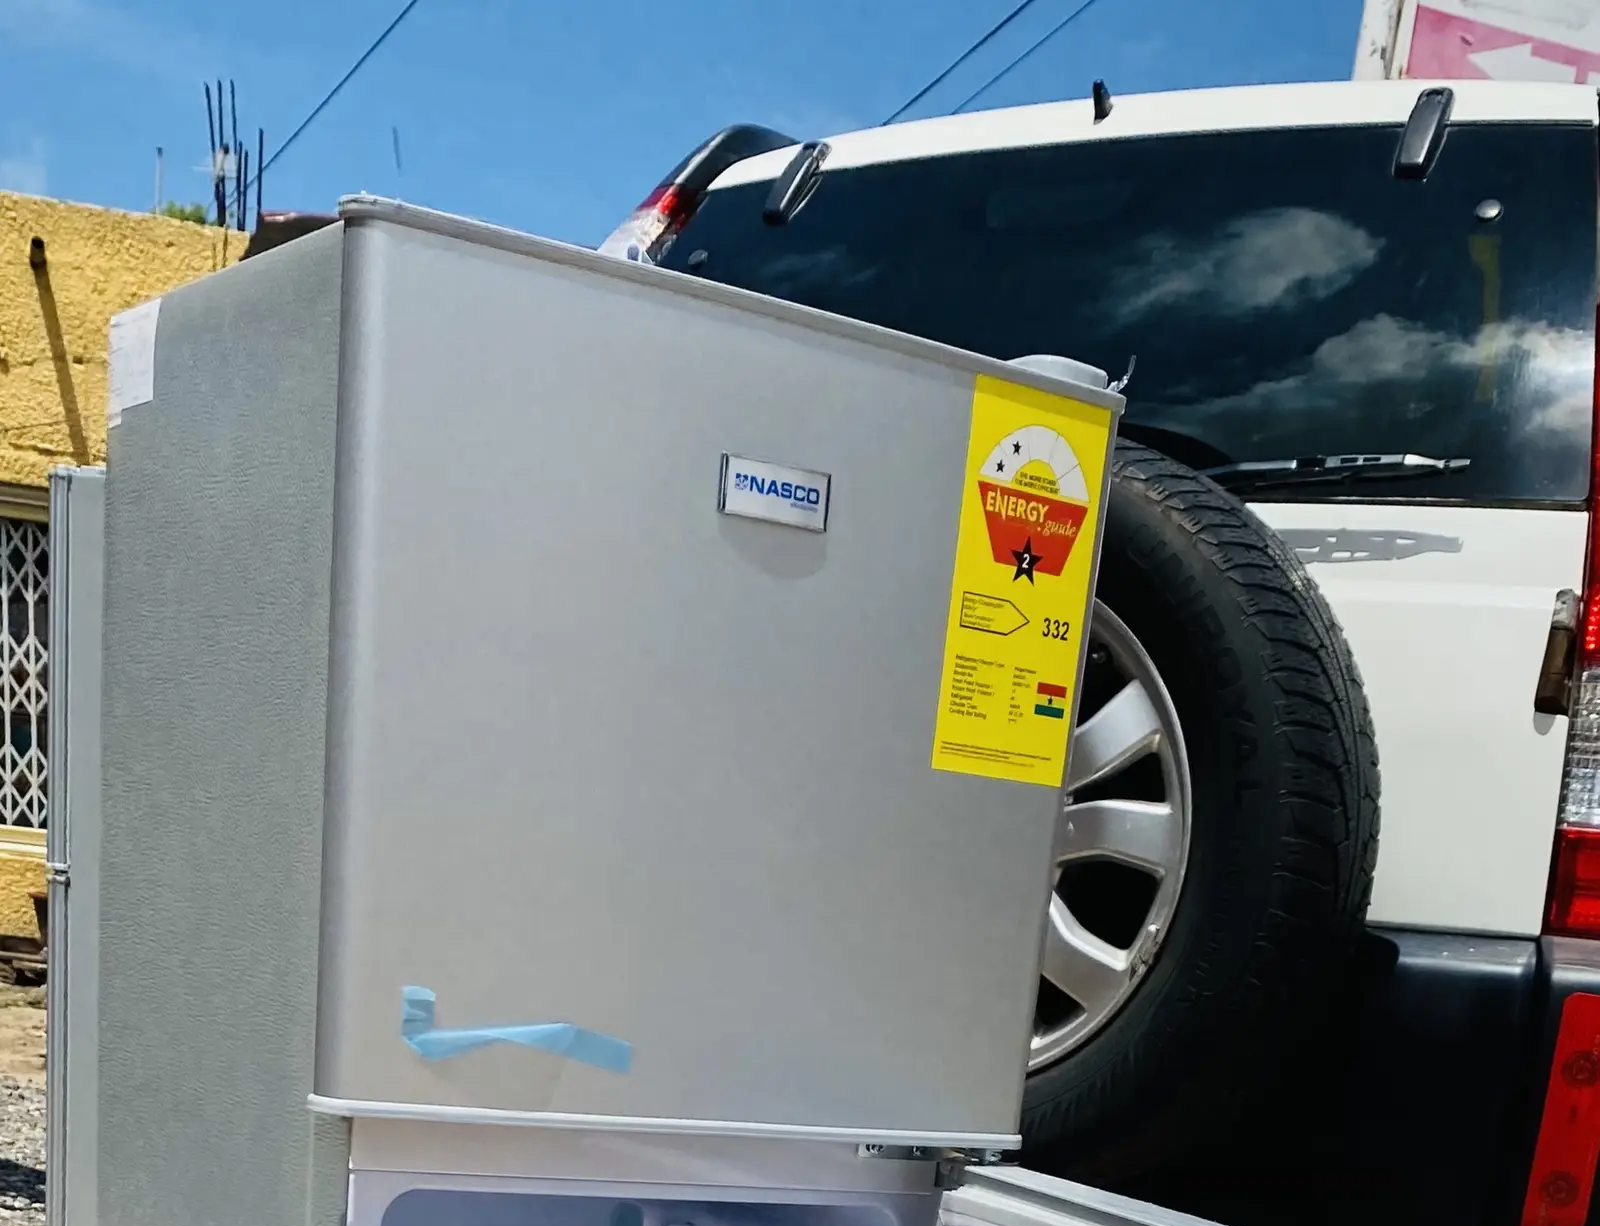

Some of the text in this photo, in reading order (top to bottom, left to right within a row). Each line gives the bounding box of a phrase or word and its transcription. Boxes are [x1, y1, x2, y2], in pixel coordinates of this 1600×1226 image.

[750, 475, 820, 505] NASCO
[986, 487, 1049, 523] ENERGY
[1043, 519, 1077, 537] guide
[1022, 553, 1030, 569] 2
[1042, 617, 1070, 641] 332
